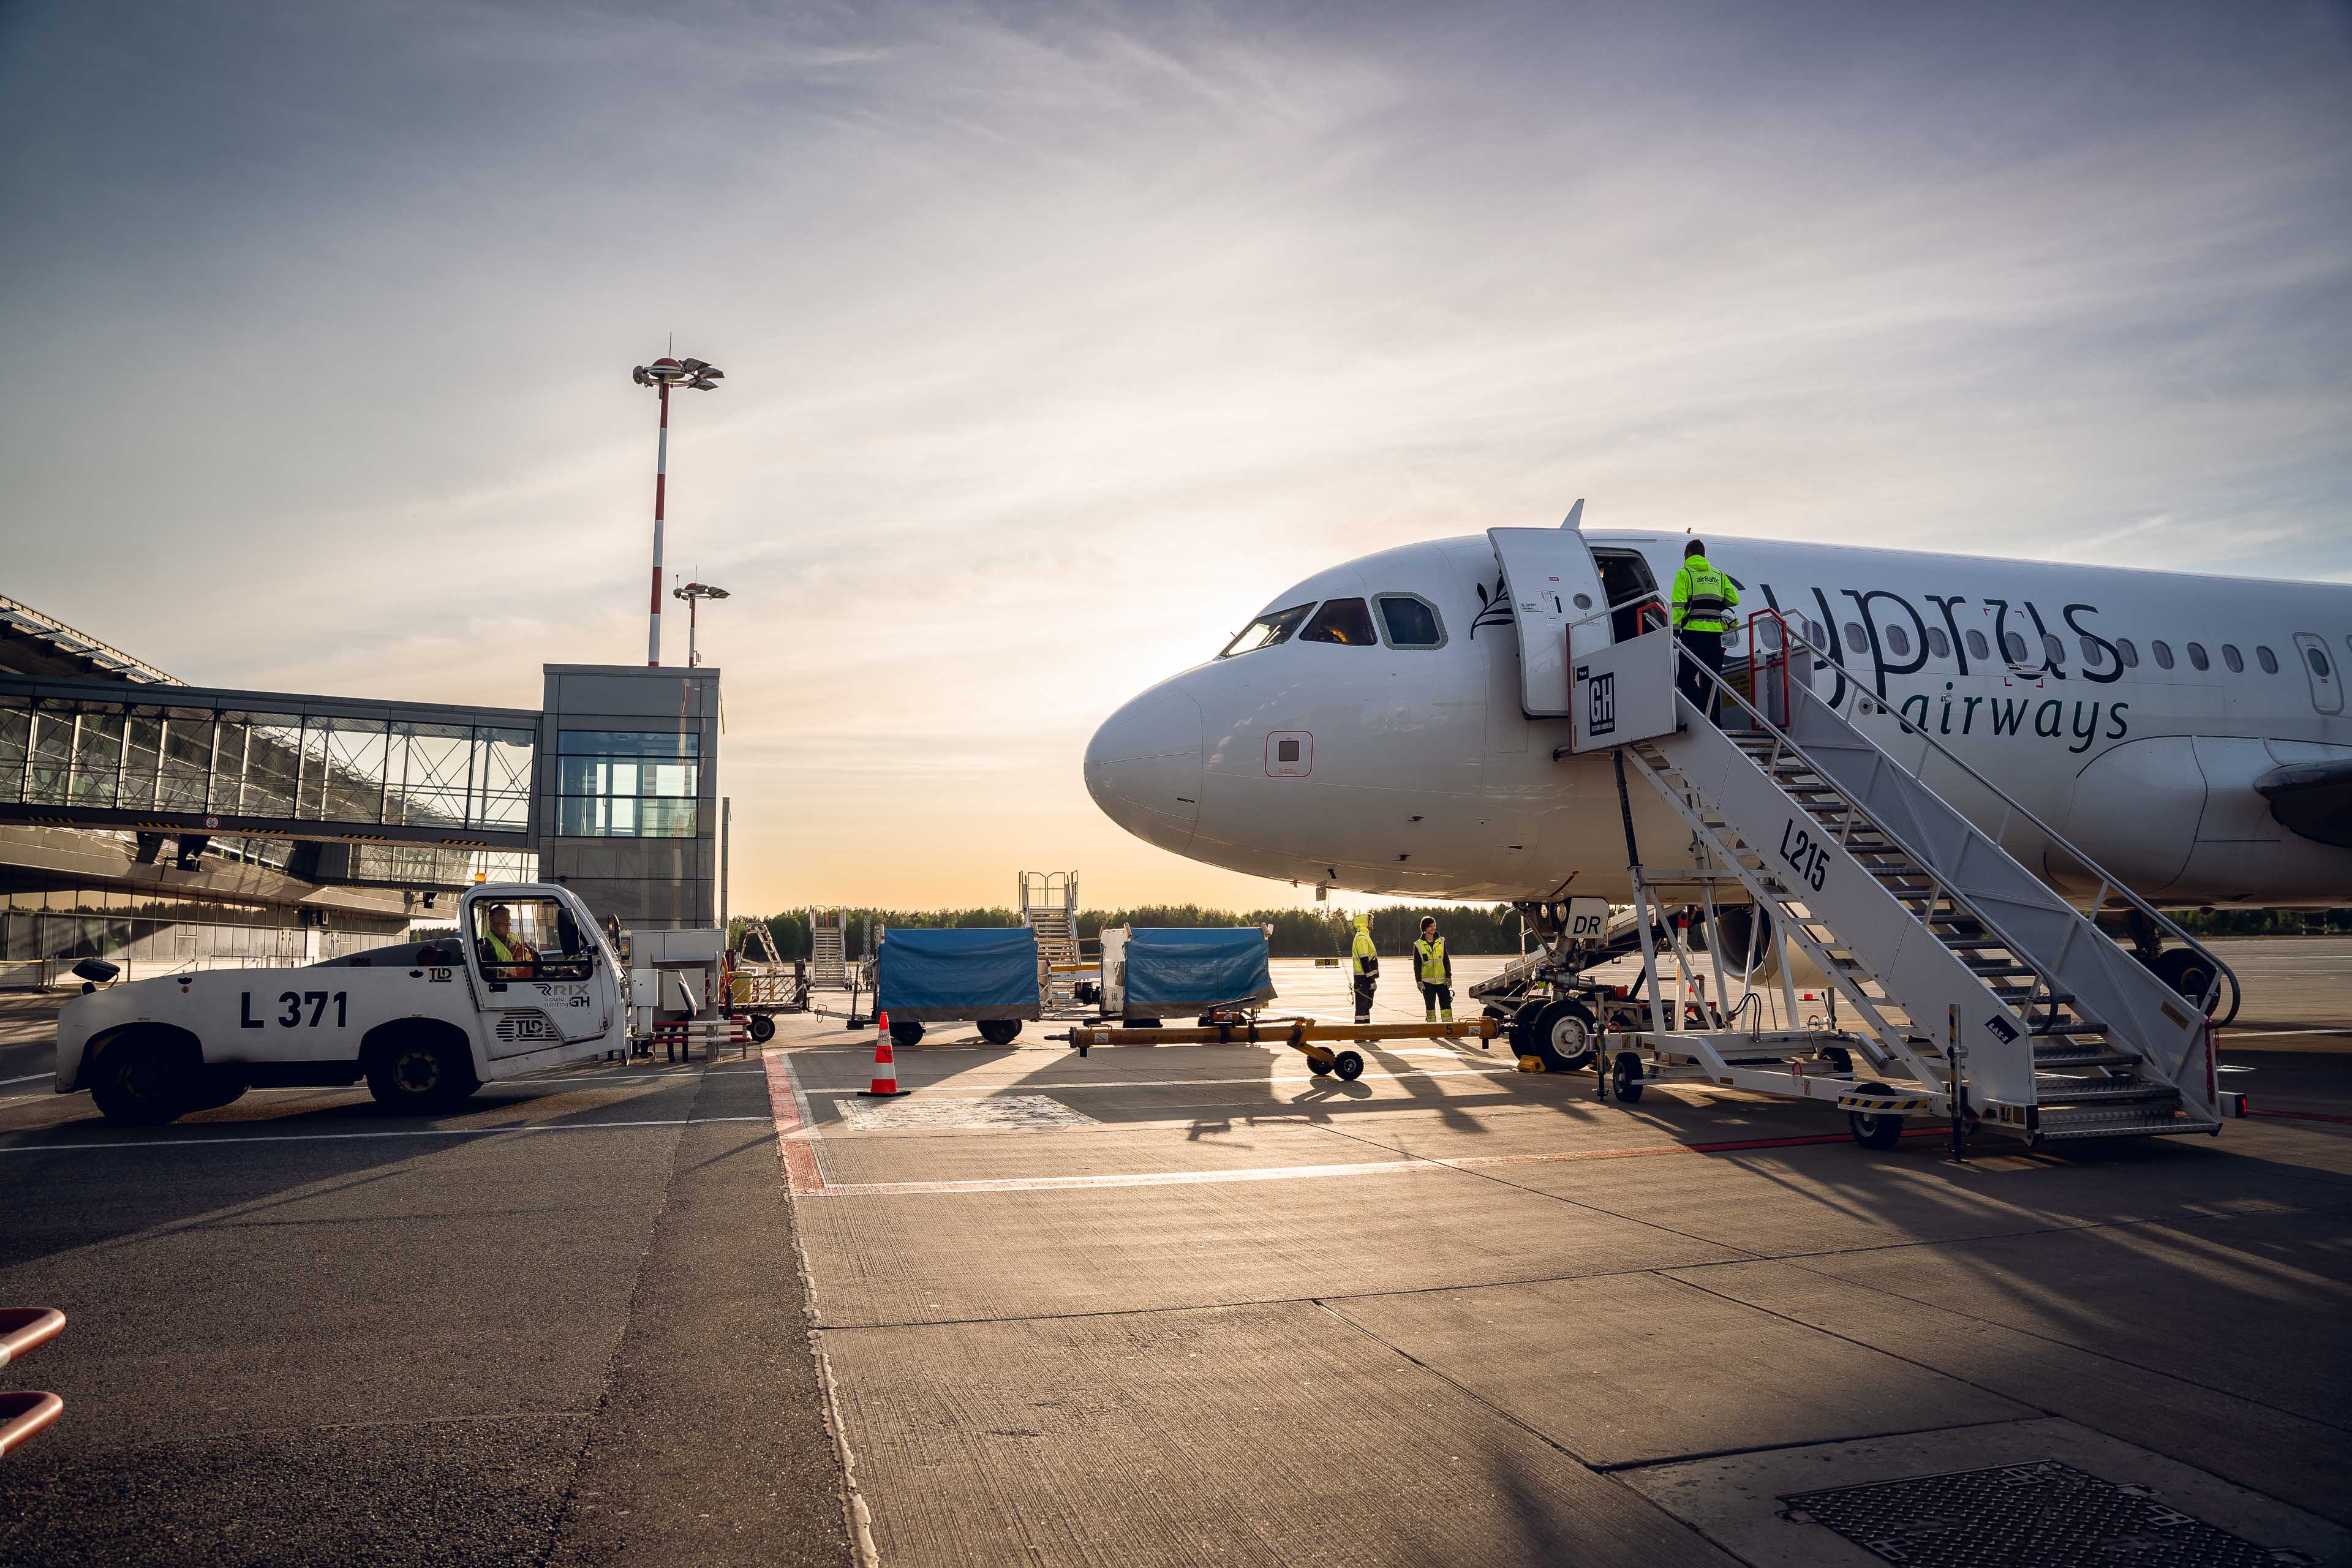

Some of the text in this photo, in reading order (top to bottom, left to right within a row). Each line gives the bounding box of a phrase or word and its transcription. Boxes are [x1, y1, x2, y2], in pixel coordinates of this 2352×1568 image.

[1591, 677, 1613, 723] GH
[1899, 681, 2128, 753] airways
[1779, 818, 1830, 892] L215
[1573, 916, 1600, 934] DR
[429, 968, 452, 981] TLD
[553, 984, 590, 995] RIX
[241, 991, 347, 1028] L 371
[515, 1019, 544, 1036] TLD
[1446, 1025, 1453, 1035] 5
